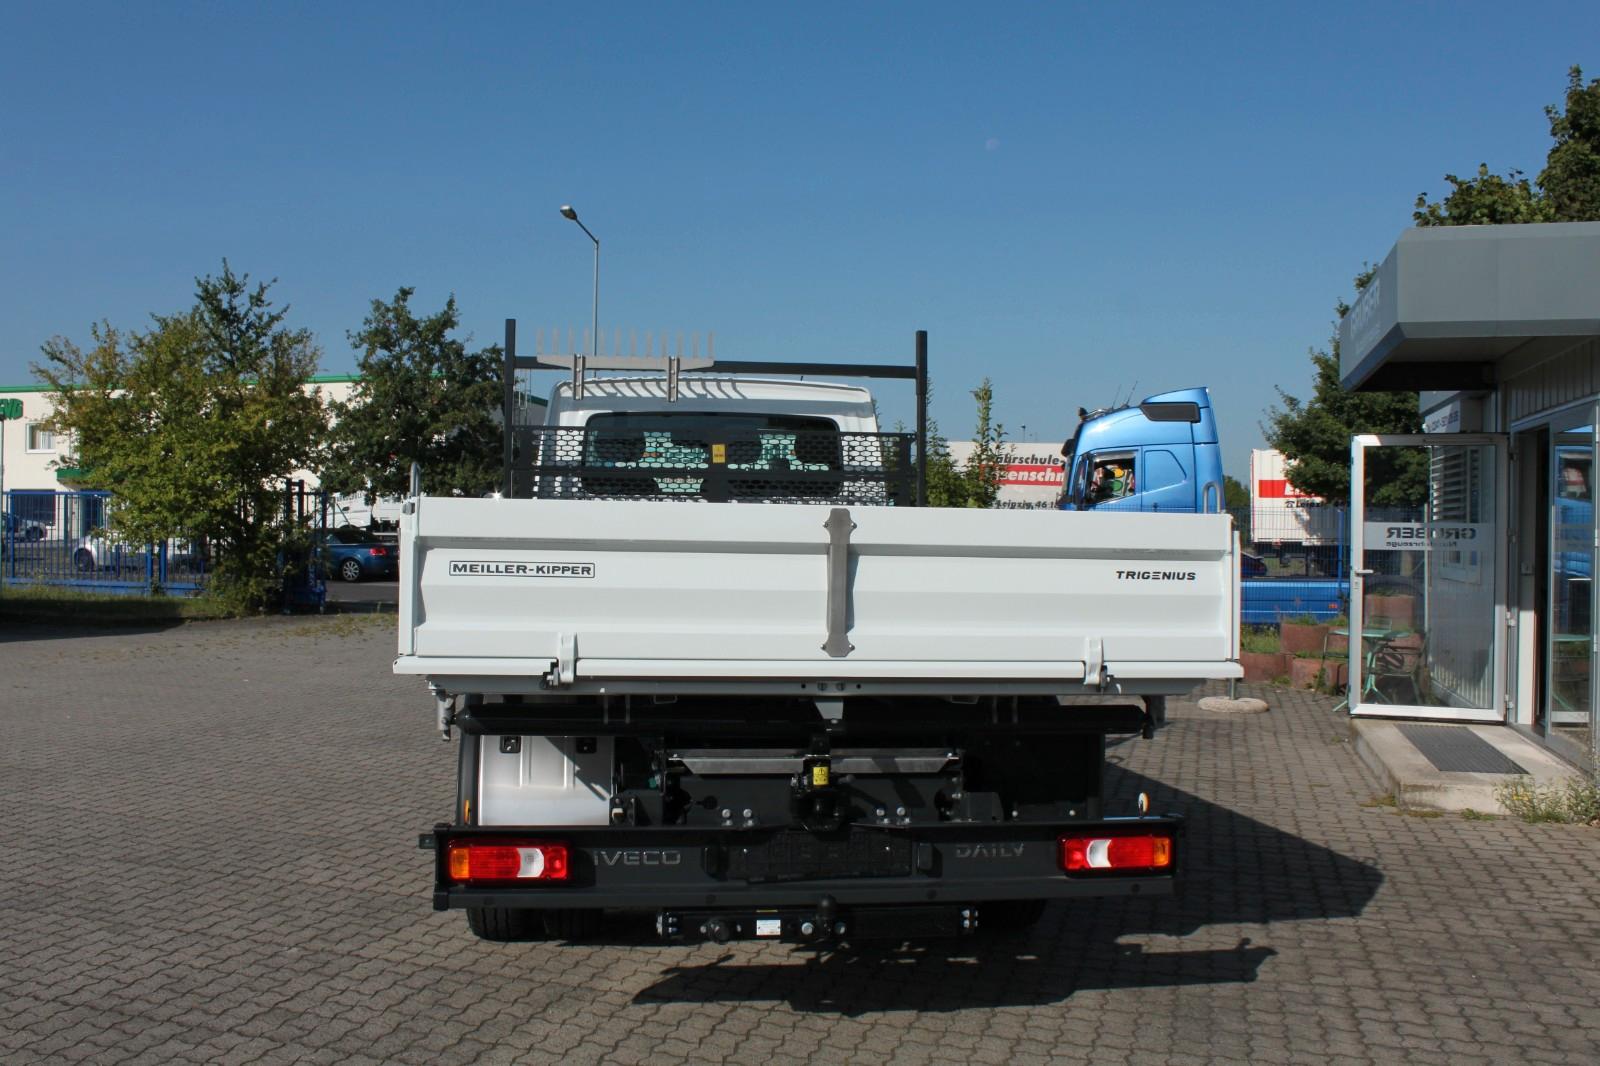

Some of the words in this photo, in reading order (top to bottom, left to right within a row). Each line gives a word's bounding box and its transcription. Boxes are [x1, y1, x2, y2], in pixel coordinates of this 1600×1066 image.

[452, 563, 592, 576] MEILLER-KIPPER
[1116, 570, 1196, 581] TRIGENIUS
[956, 842, 1025, 858] DAILY
[594, 850, 681, 866] IVECO
